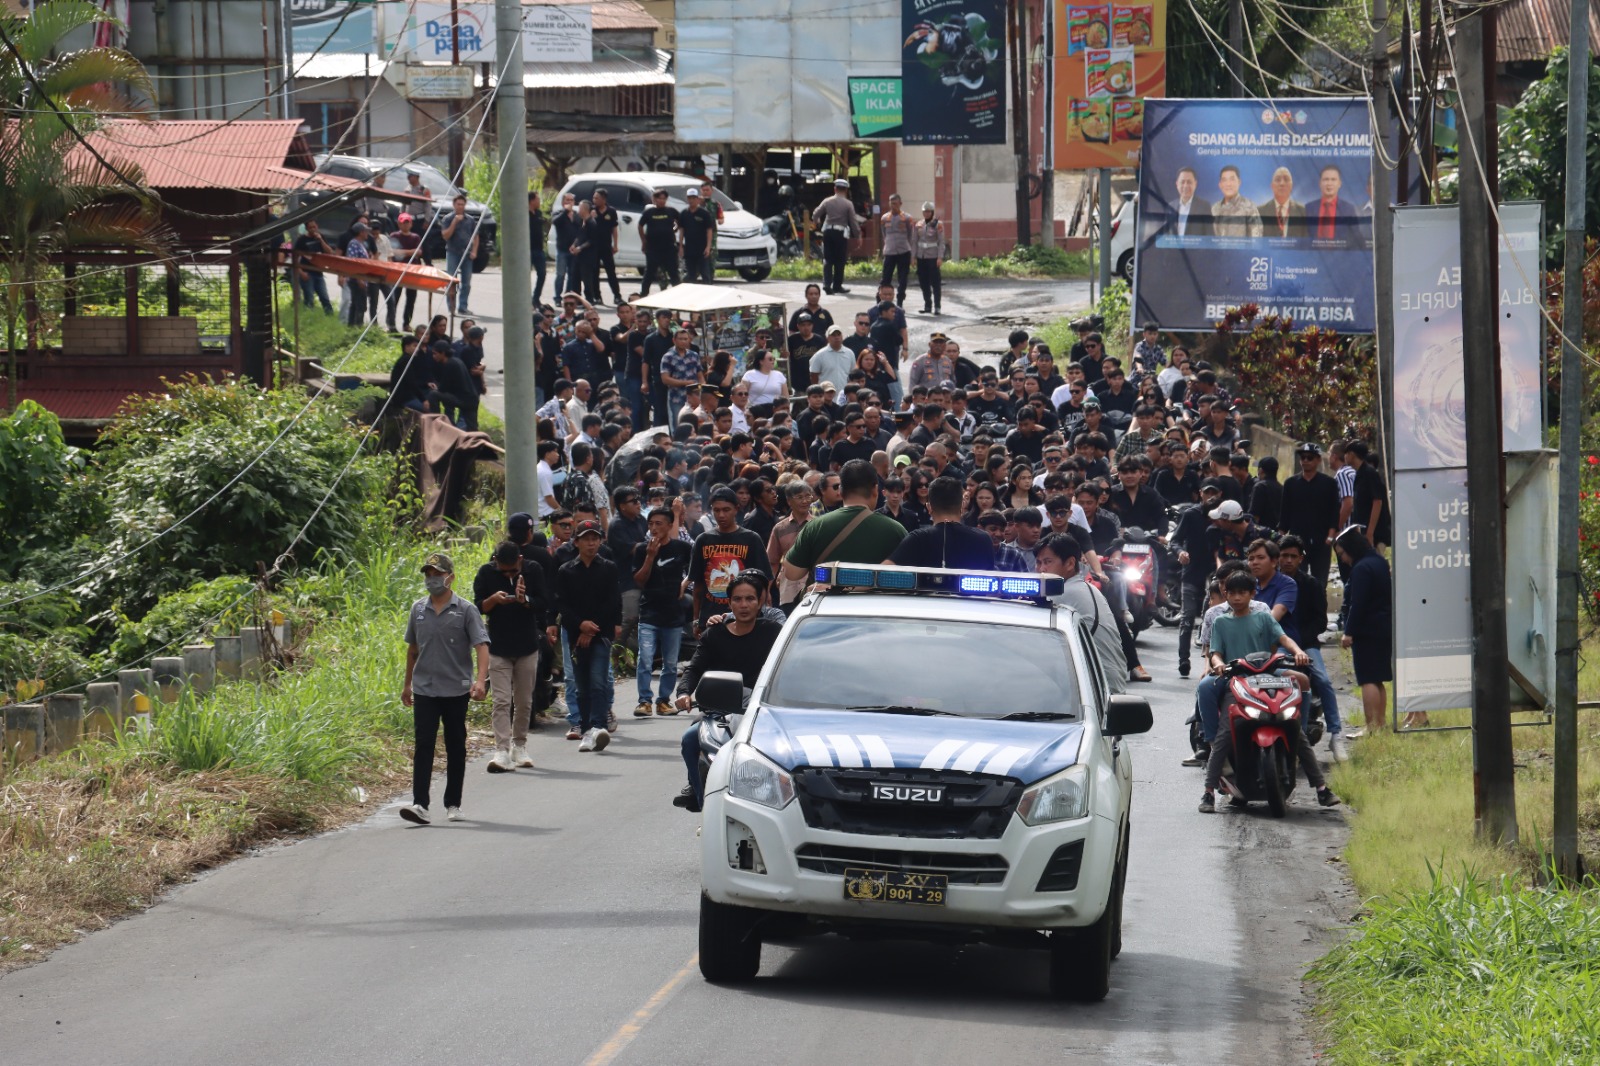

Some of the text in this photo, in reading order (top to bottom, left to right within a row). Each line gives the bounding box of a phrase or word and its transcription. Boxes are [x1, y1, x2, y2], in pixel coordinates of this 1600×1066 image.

[851, 82, 896, 94] SPACE
[865, 98, 902, 110] IKLAN
[1188, 133, 1373, 147] SIDANG MAJELIS DAERAH UMU
[1197, 147, 1221, 157] Gereja
[1222, 147, 1245, 156] Bethel
[1246, 147, 1279, 156] Indonesia
[1280, 147, 1312, 157] Sulawesi
[1313, 148, 1331, 157] Utara
[1333, 148, 1338, 157] &
[1251, 257, 1268, 272] 25
[1275, 266, 1286, 274] The
[1303, 267, 1318, 275] Hotel
[1246, 271, 1267, 282] Juni
[1249, 282, 1268, 291] 2025
[1205, 303, 1355, 322] BEMA KITA BISA
[873, 786, 942, 802] ISUZU
[904, 874, 930, 887] XV
[889, 888, 913, 900] 901
[926, 890, 943, 902] 29
